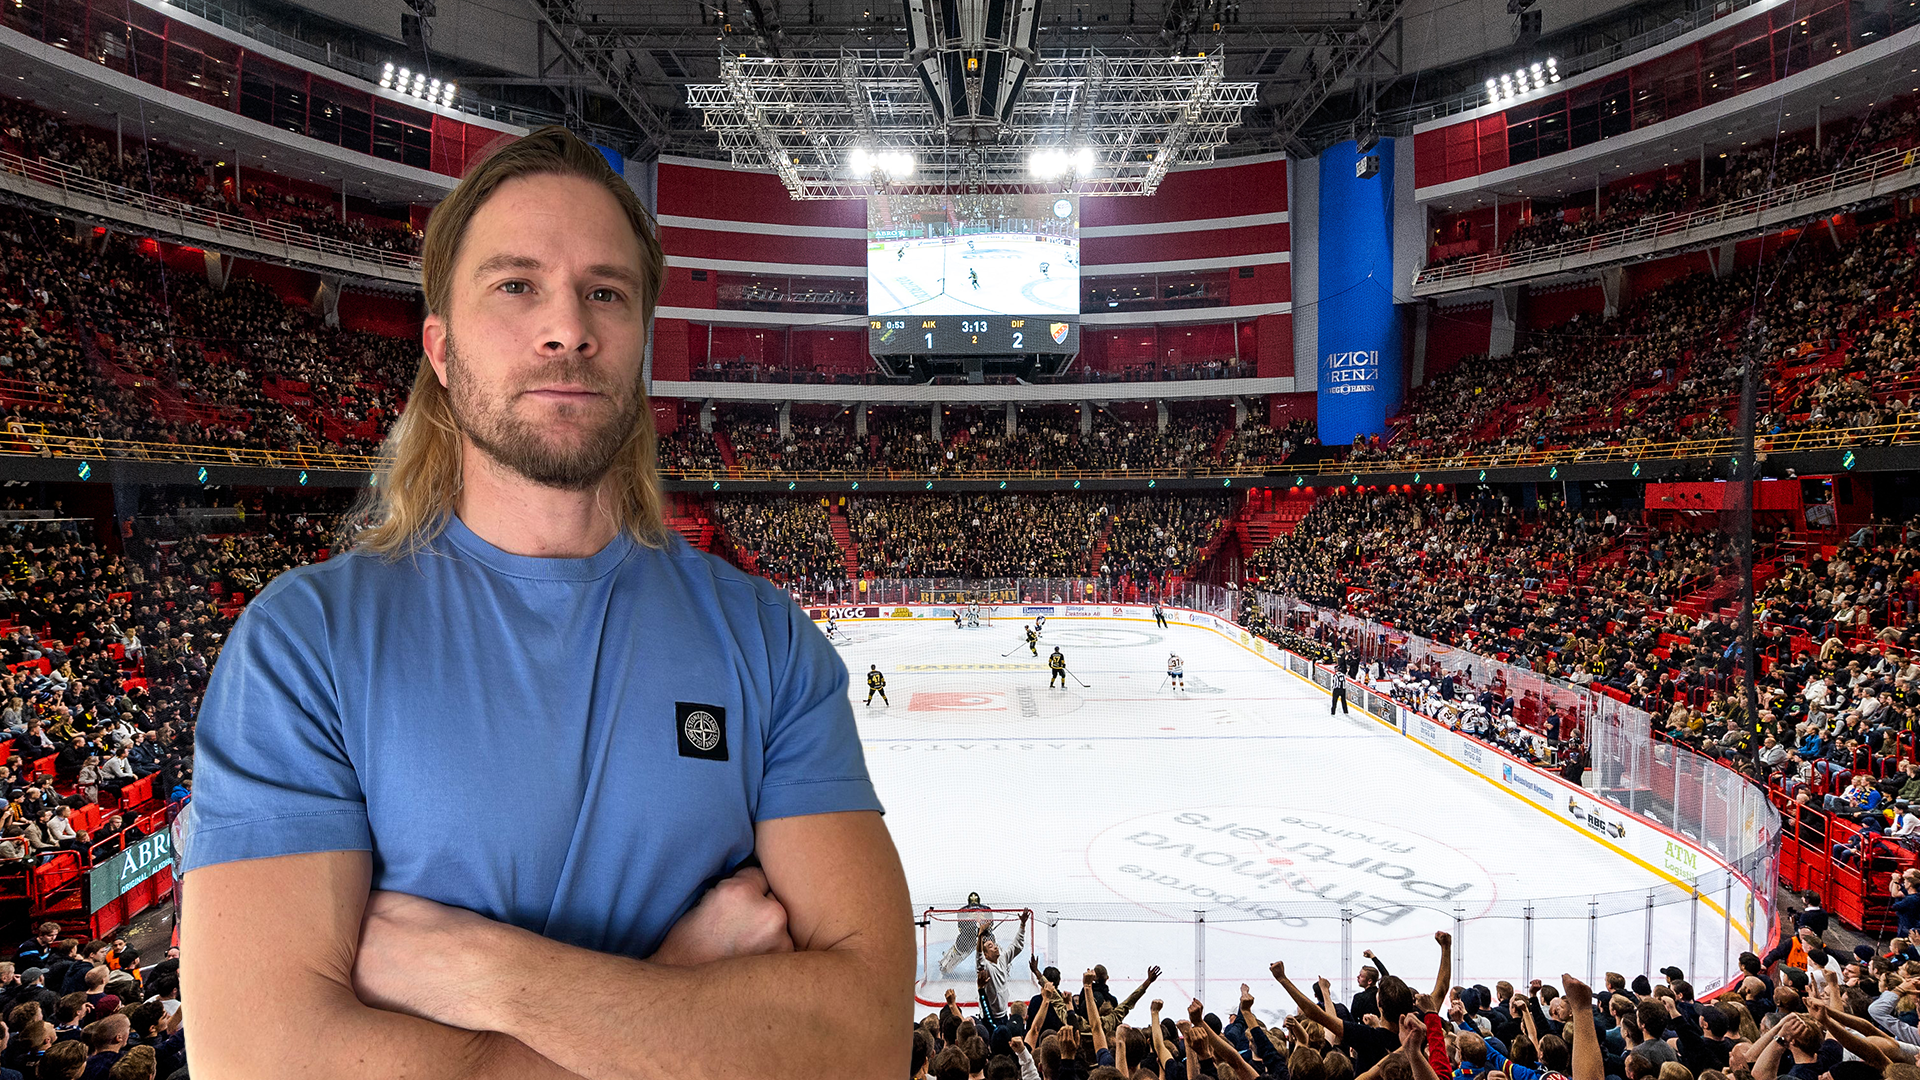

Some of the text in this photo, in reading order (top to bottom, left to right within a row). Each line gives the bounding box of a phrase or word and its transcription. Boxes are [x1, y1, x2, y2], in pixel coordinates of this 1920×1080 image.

[870, 321, 881, 329] 78
[886, 321, 905, 329] 0:53
[922, 320, 936, 329] AIK
[961, 321, 988, 333] 3:13
[1011, 320, 1025, 328] DIF
[924, 332, 933, 349] 1
[971, 335, 978, 344] 2
[1012, 332, 1023, 349] 2
[1323, 369, 1378, 383] ARENA
[1587, 813, 1606, 830] RBG
[1281, 815, 1416, 855] finance
[1173, 811, 1473, 901] Partners
[1665, 840, 1697, 870] ATM
[121, 872, 148, 895] ORIGINAL
[1124, 831, 1416, 927] Eminova
[1118, 863, 1308, 928] corporate
